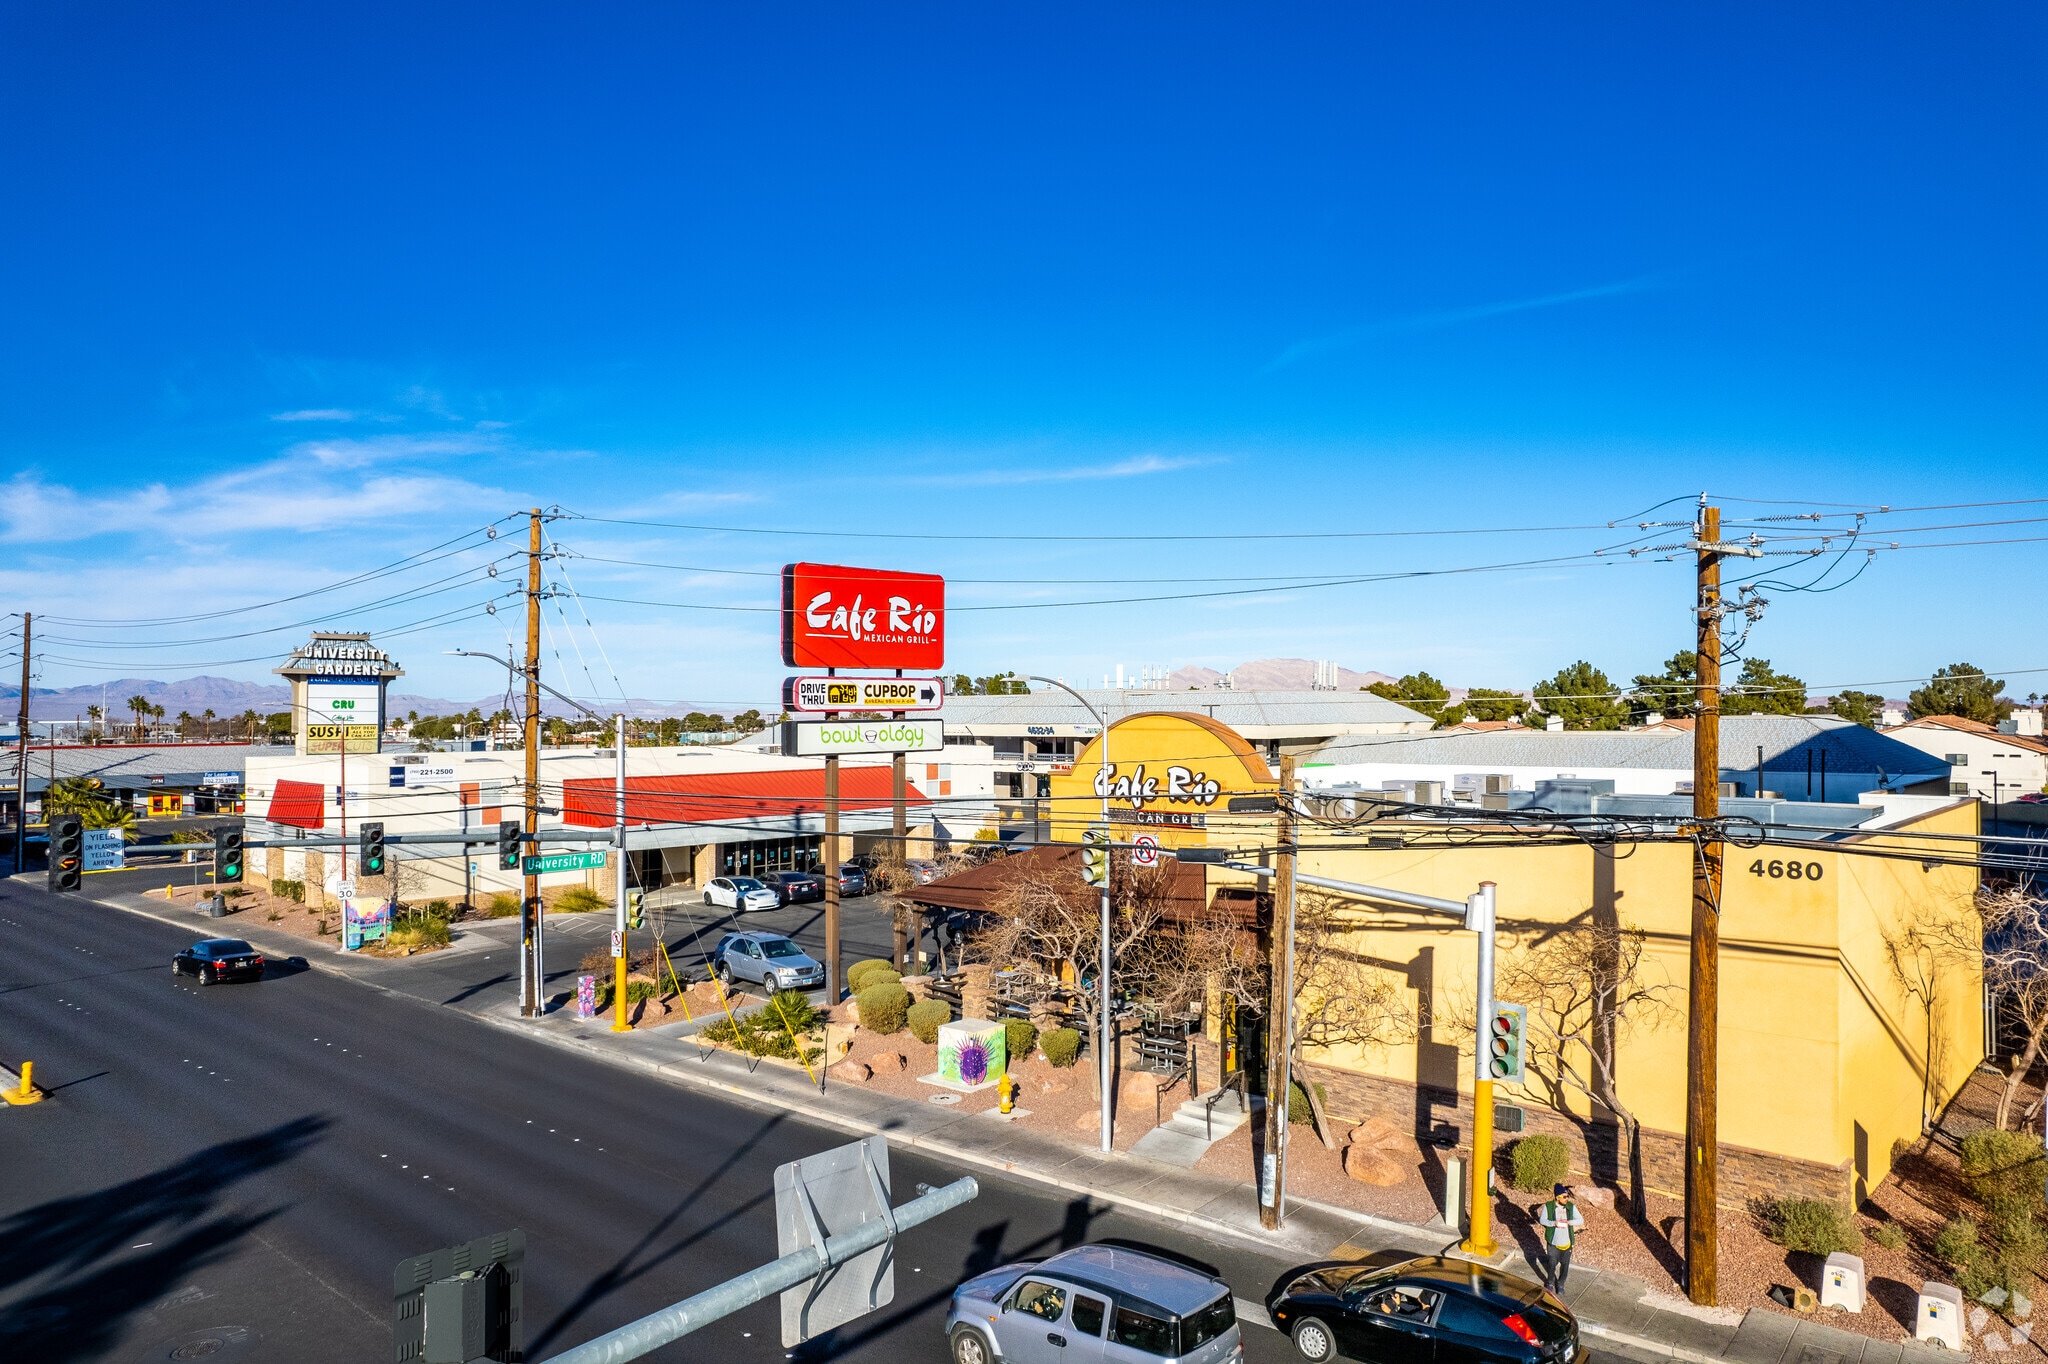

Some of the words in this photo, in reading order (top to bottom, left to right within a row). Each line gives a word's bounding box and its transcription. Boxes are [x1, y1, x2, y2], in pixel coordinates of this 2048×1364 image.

[806, 591, 877, 641] Cafe
[888, 596, 936, 634] Rio
[863, 634, 904, 643] MEXICAN
[906, 635, 930, 644] GRILL
[304, 646, 387, 660] UNIVERSITY
[315, 664, 380, 676] GARDENS
[800, 683, 826, 694] DRIVE
[864, 684, 916, 698] CUPBOP
[332, 699, 355, 709] CRU
[801, 695, 825, 705] THRU
[309, 726, 350, 738] SUSHI
[1094, 764, 1158, 808] Cafe
[1168, 766, 1221, 806] Rio
[528, 855, 584, 870] University
[590, 852, 604, 864] RD
[1749, 859, 1823, 881] 4680
[339, 890, 353, 898] 30
